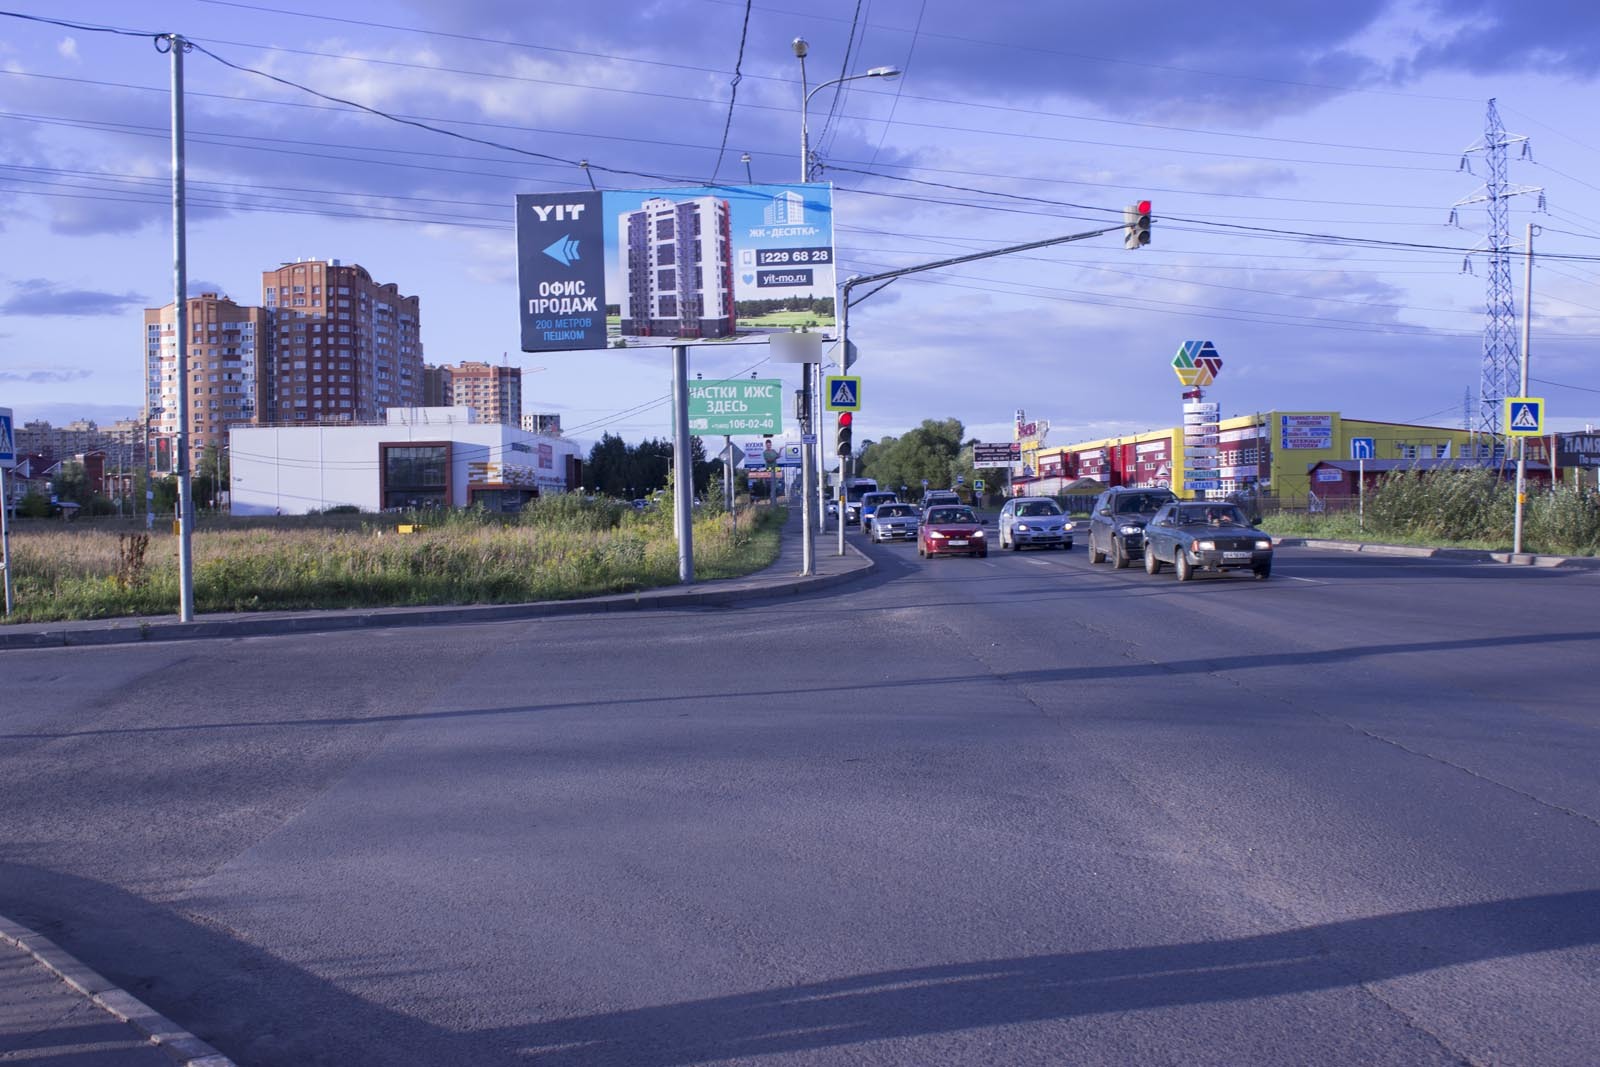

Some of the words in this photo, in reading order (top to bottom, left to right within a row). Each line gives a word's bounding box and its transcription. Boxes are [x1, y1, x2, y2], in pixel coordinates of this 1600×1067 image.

[532, 204, 585, 222] YIT
[749, 228, 766, 238] ЖК
[765, 252, 790, 263] 229
[792, 251, 809, 261] 68
[812, 250, 829, 261] 28
[763, 274, 807, 285] yit-mo.ru
[538, 280, 586, 298] ОФИС
[528, 297, 599, 316] ПРОДАЖ
[535, 319, 553, 330] 200
[554, 317, 592, 329] МЕТРОВ
[543, 330, 585, 341] ПЕШКОМ
[688, 386, 737, 399] ЧАСТКИ
[744, 386, 774, 398] ИЖС
[706, 400, 748, 414] ЗДЕСЬ
[1189, 481, 1214, 489] МЕТАЛЛ
